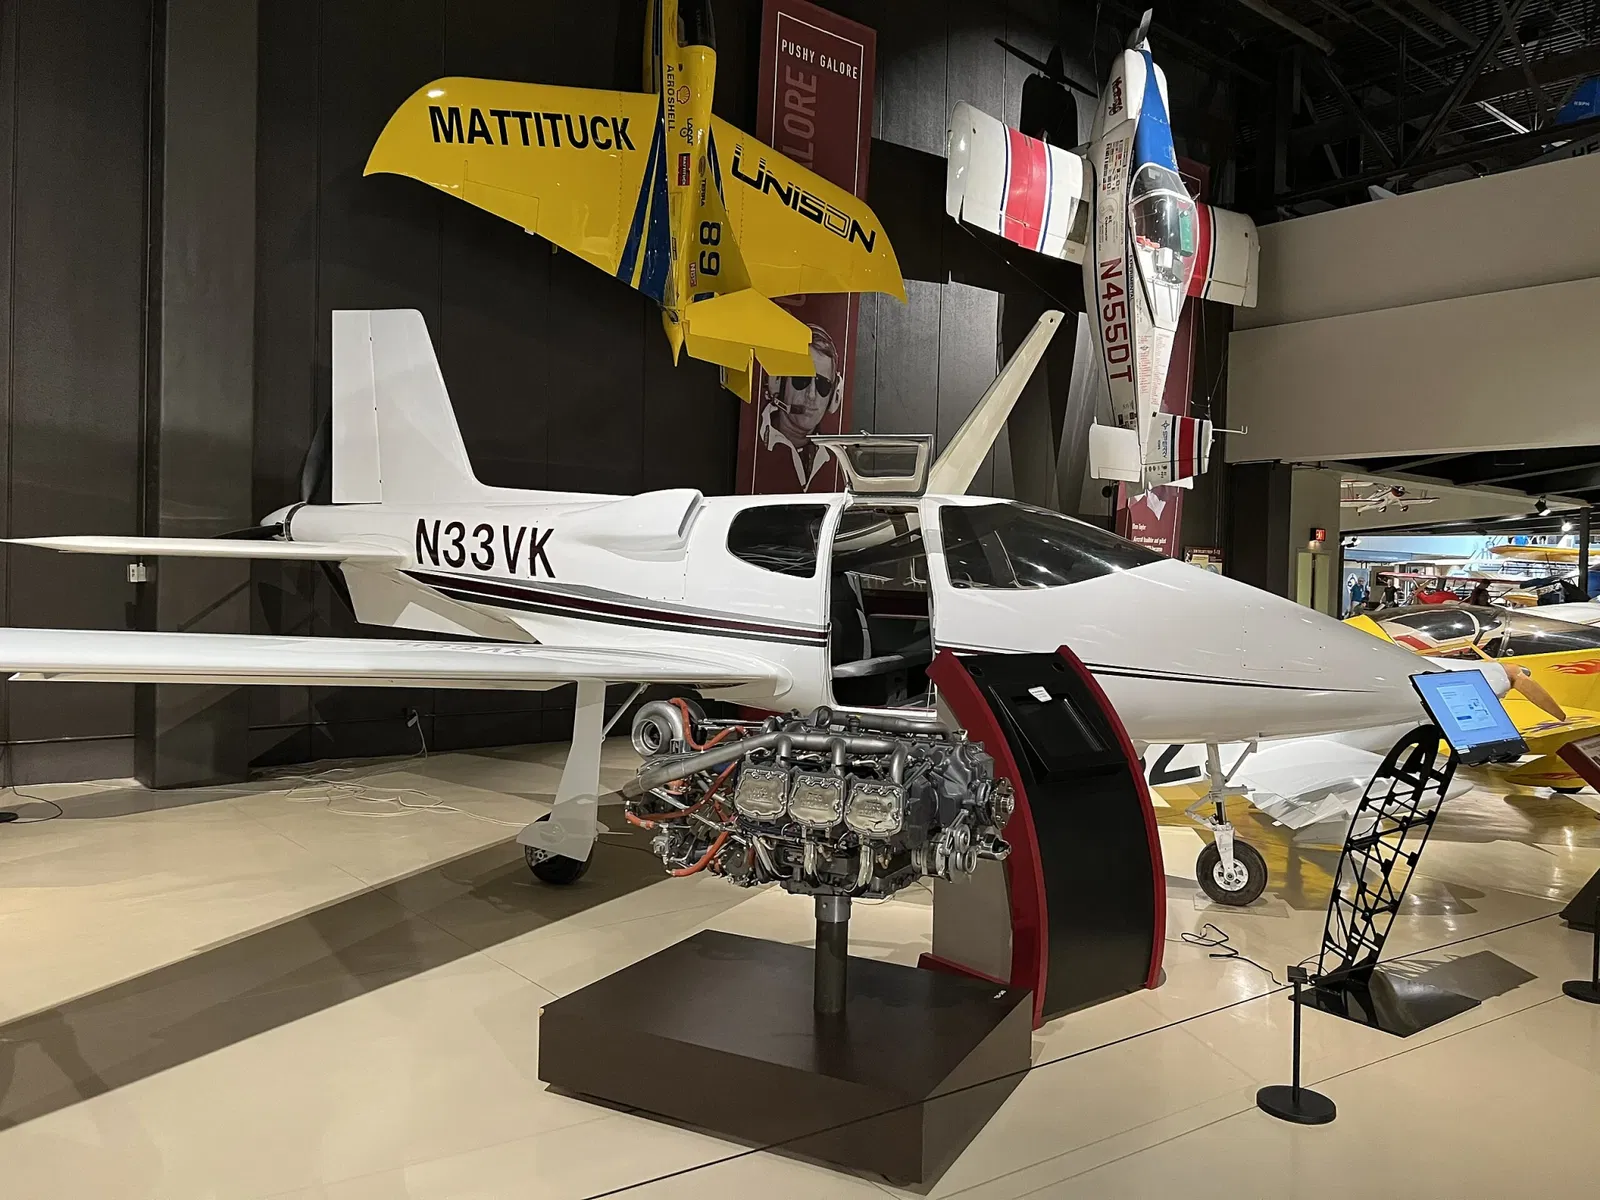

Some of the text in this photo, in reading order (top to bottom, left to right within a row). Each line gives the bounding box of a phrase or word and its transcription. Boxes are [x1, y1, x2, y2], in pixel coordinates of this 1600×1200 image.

[781, 39, 858, 80] PUSHY GALORE
[428, 105, 636, 151] MATTITUCK
[666, 64, 675, 132] AEROSHELL
[781, 64, 817, 169] LORE
[731, 143, 876, 253] UNISON
[1100, 258, 1132, 383] N455DT
[415, 518, 556, 579] N33VK
